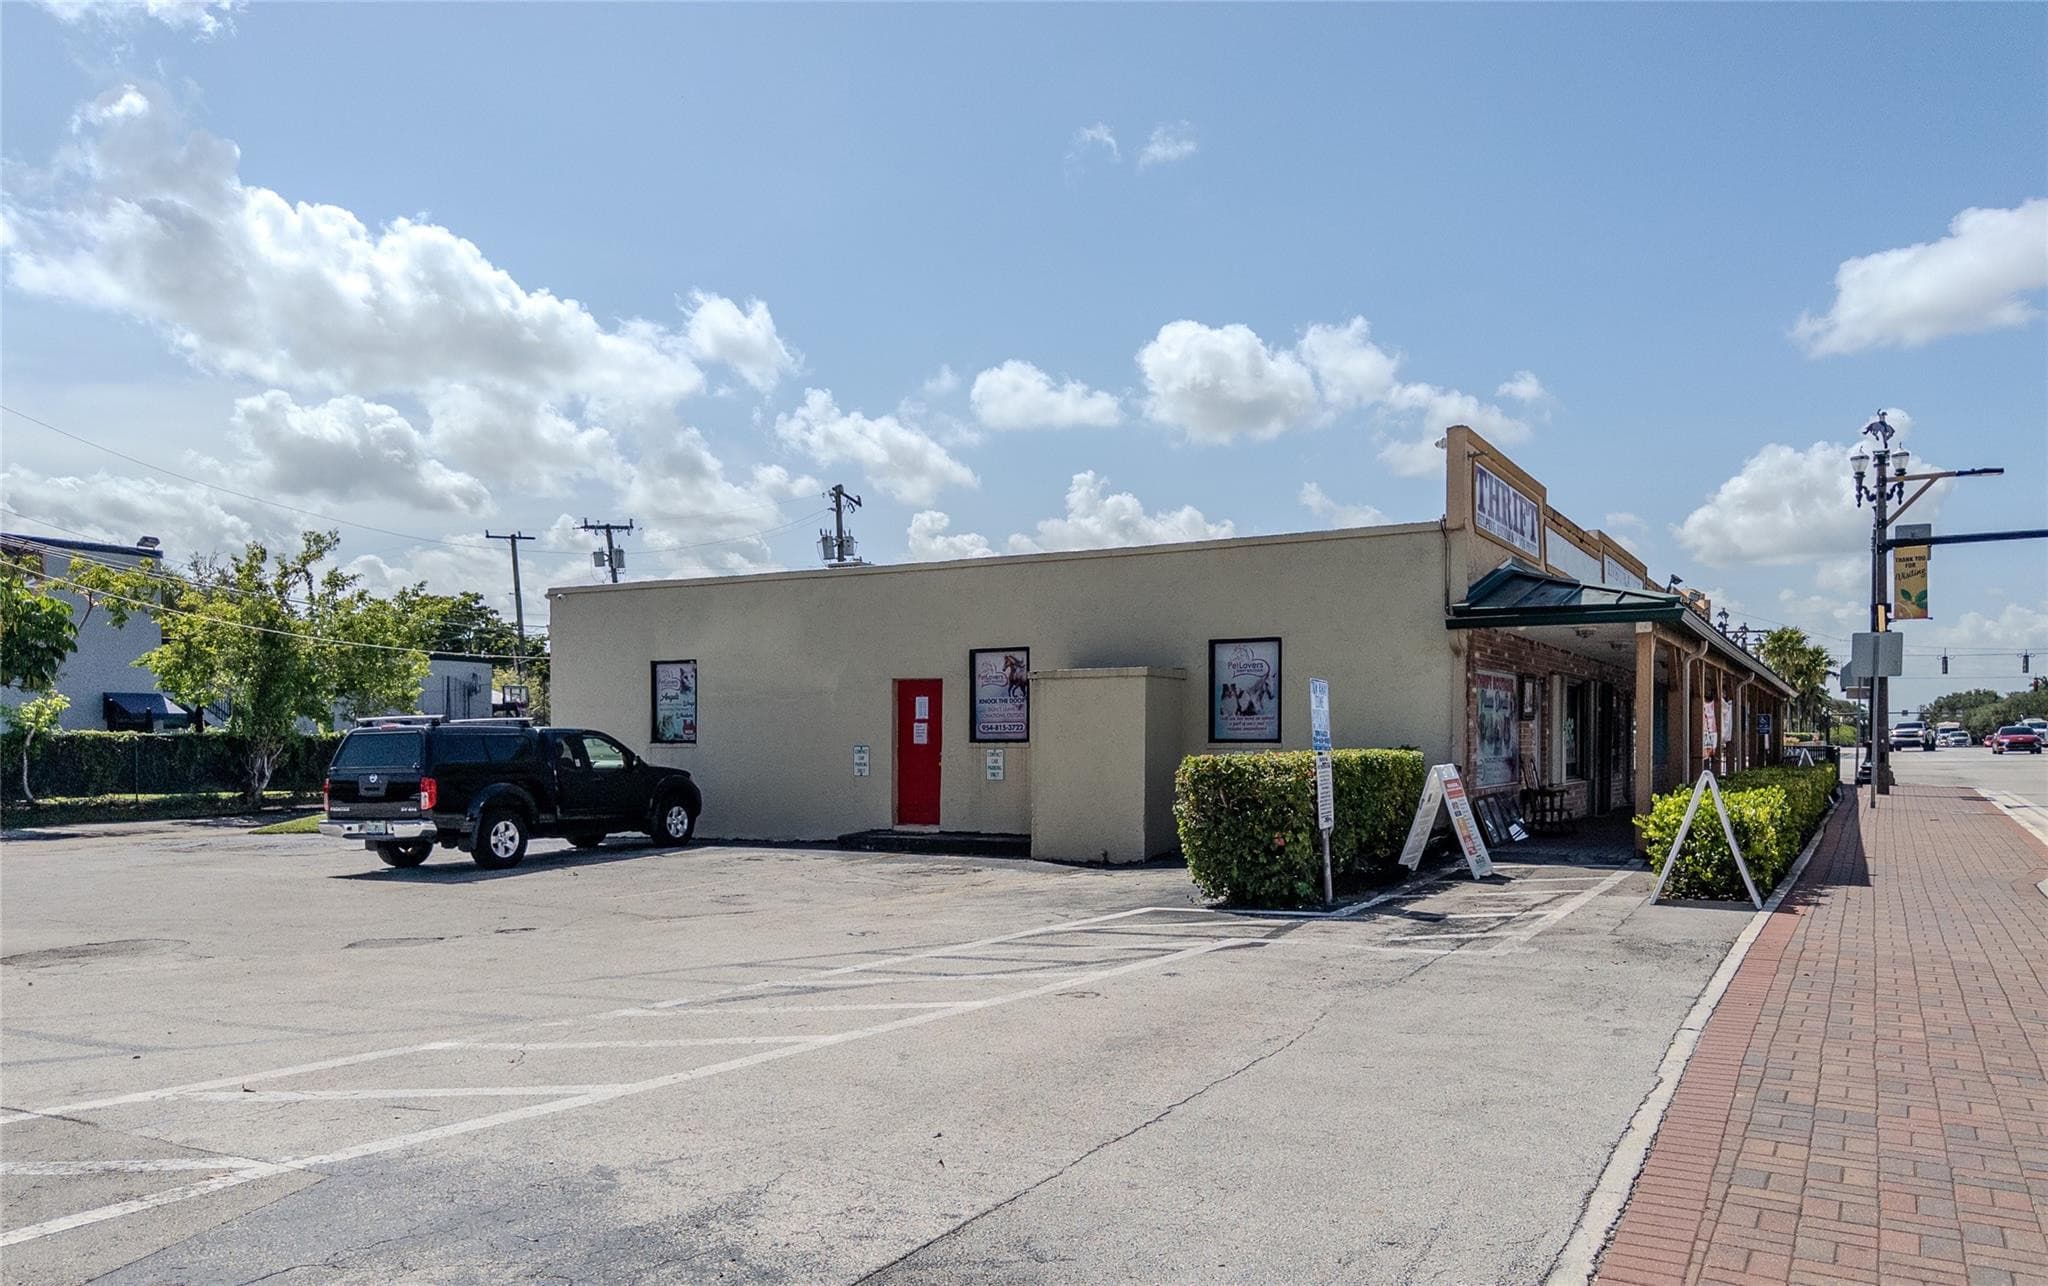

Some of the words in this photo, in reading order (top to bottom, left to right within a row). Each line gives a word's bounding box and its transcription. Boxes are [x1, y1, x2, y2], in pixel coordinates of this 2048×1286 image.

[1476, 468, 1538, 543] THRIFT
[1896, 569, 1926, 581] Visiting
[979, 697, 997, 705] KNOCK
